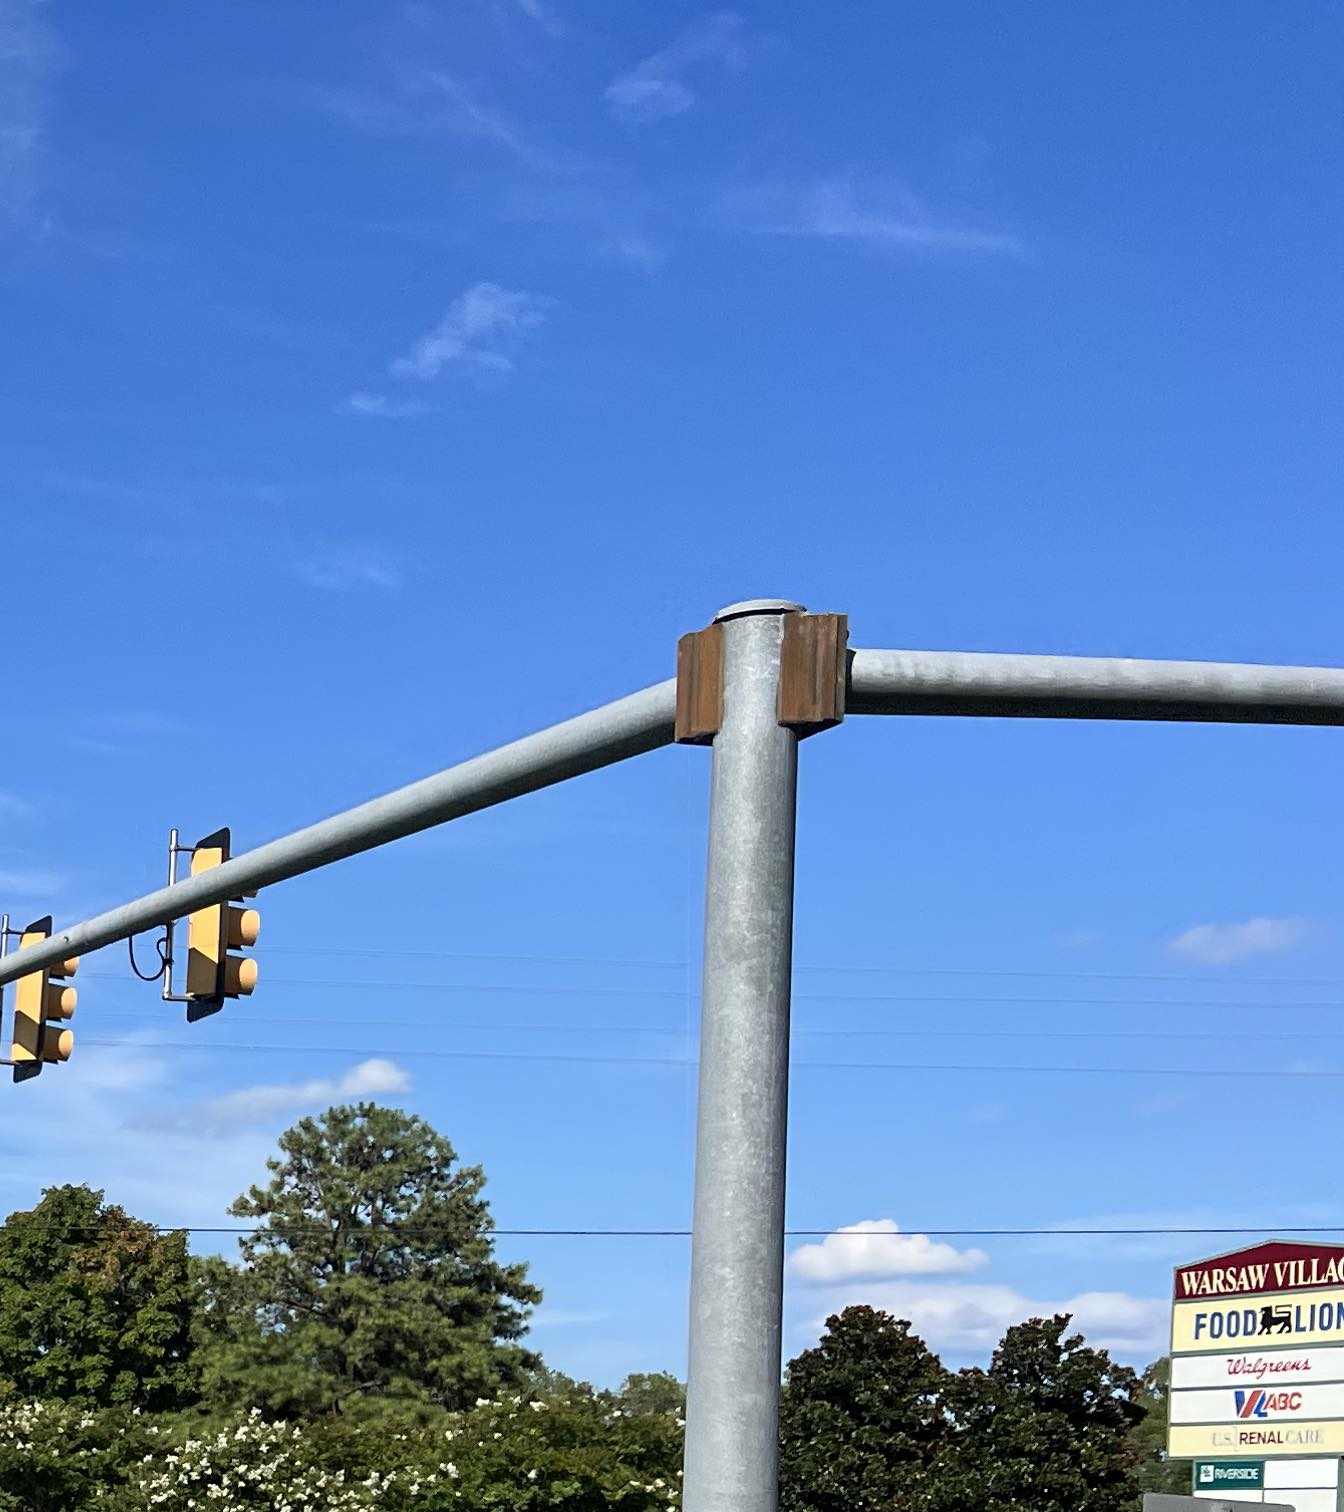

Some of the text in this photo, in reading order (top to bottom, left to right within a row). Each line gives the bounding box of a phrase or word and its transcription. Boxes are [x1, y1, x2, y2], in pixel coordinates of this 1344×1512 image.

[1181, 1264, 1269, 1296] WARSAW
[1194, 1309, 1257, 1340] FOOD
[1227, 1357, 1311, 1379] Walgreens
[1239, 1430, 1284, 1445] RENAL
[1214, 1468, 1259, 1480] RIVERSIDE
